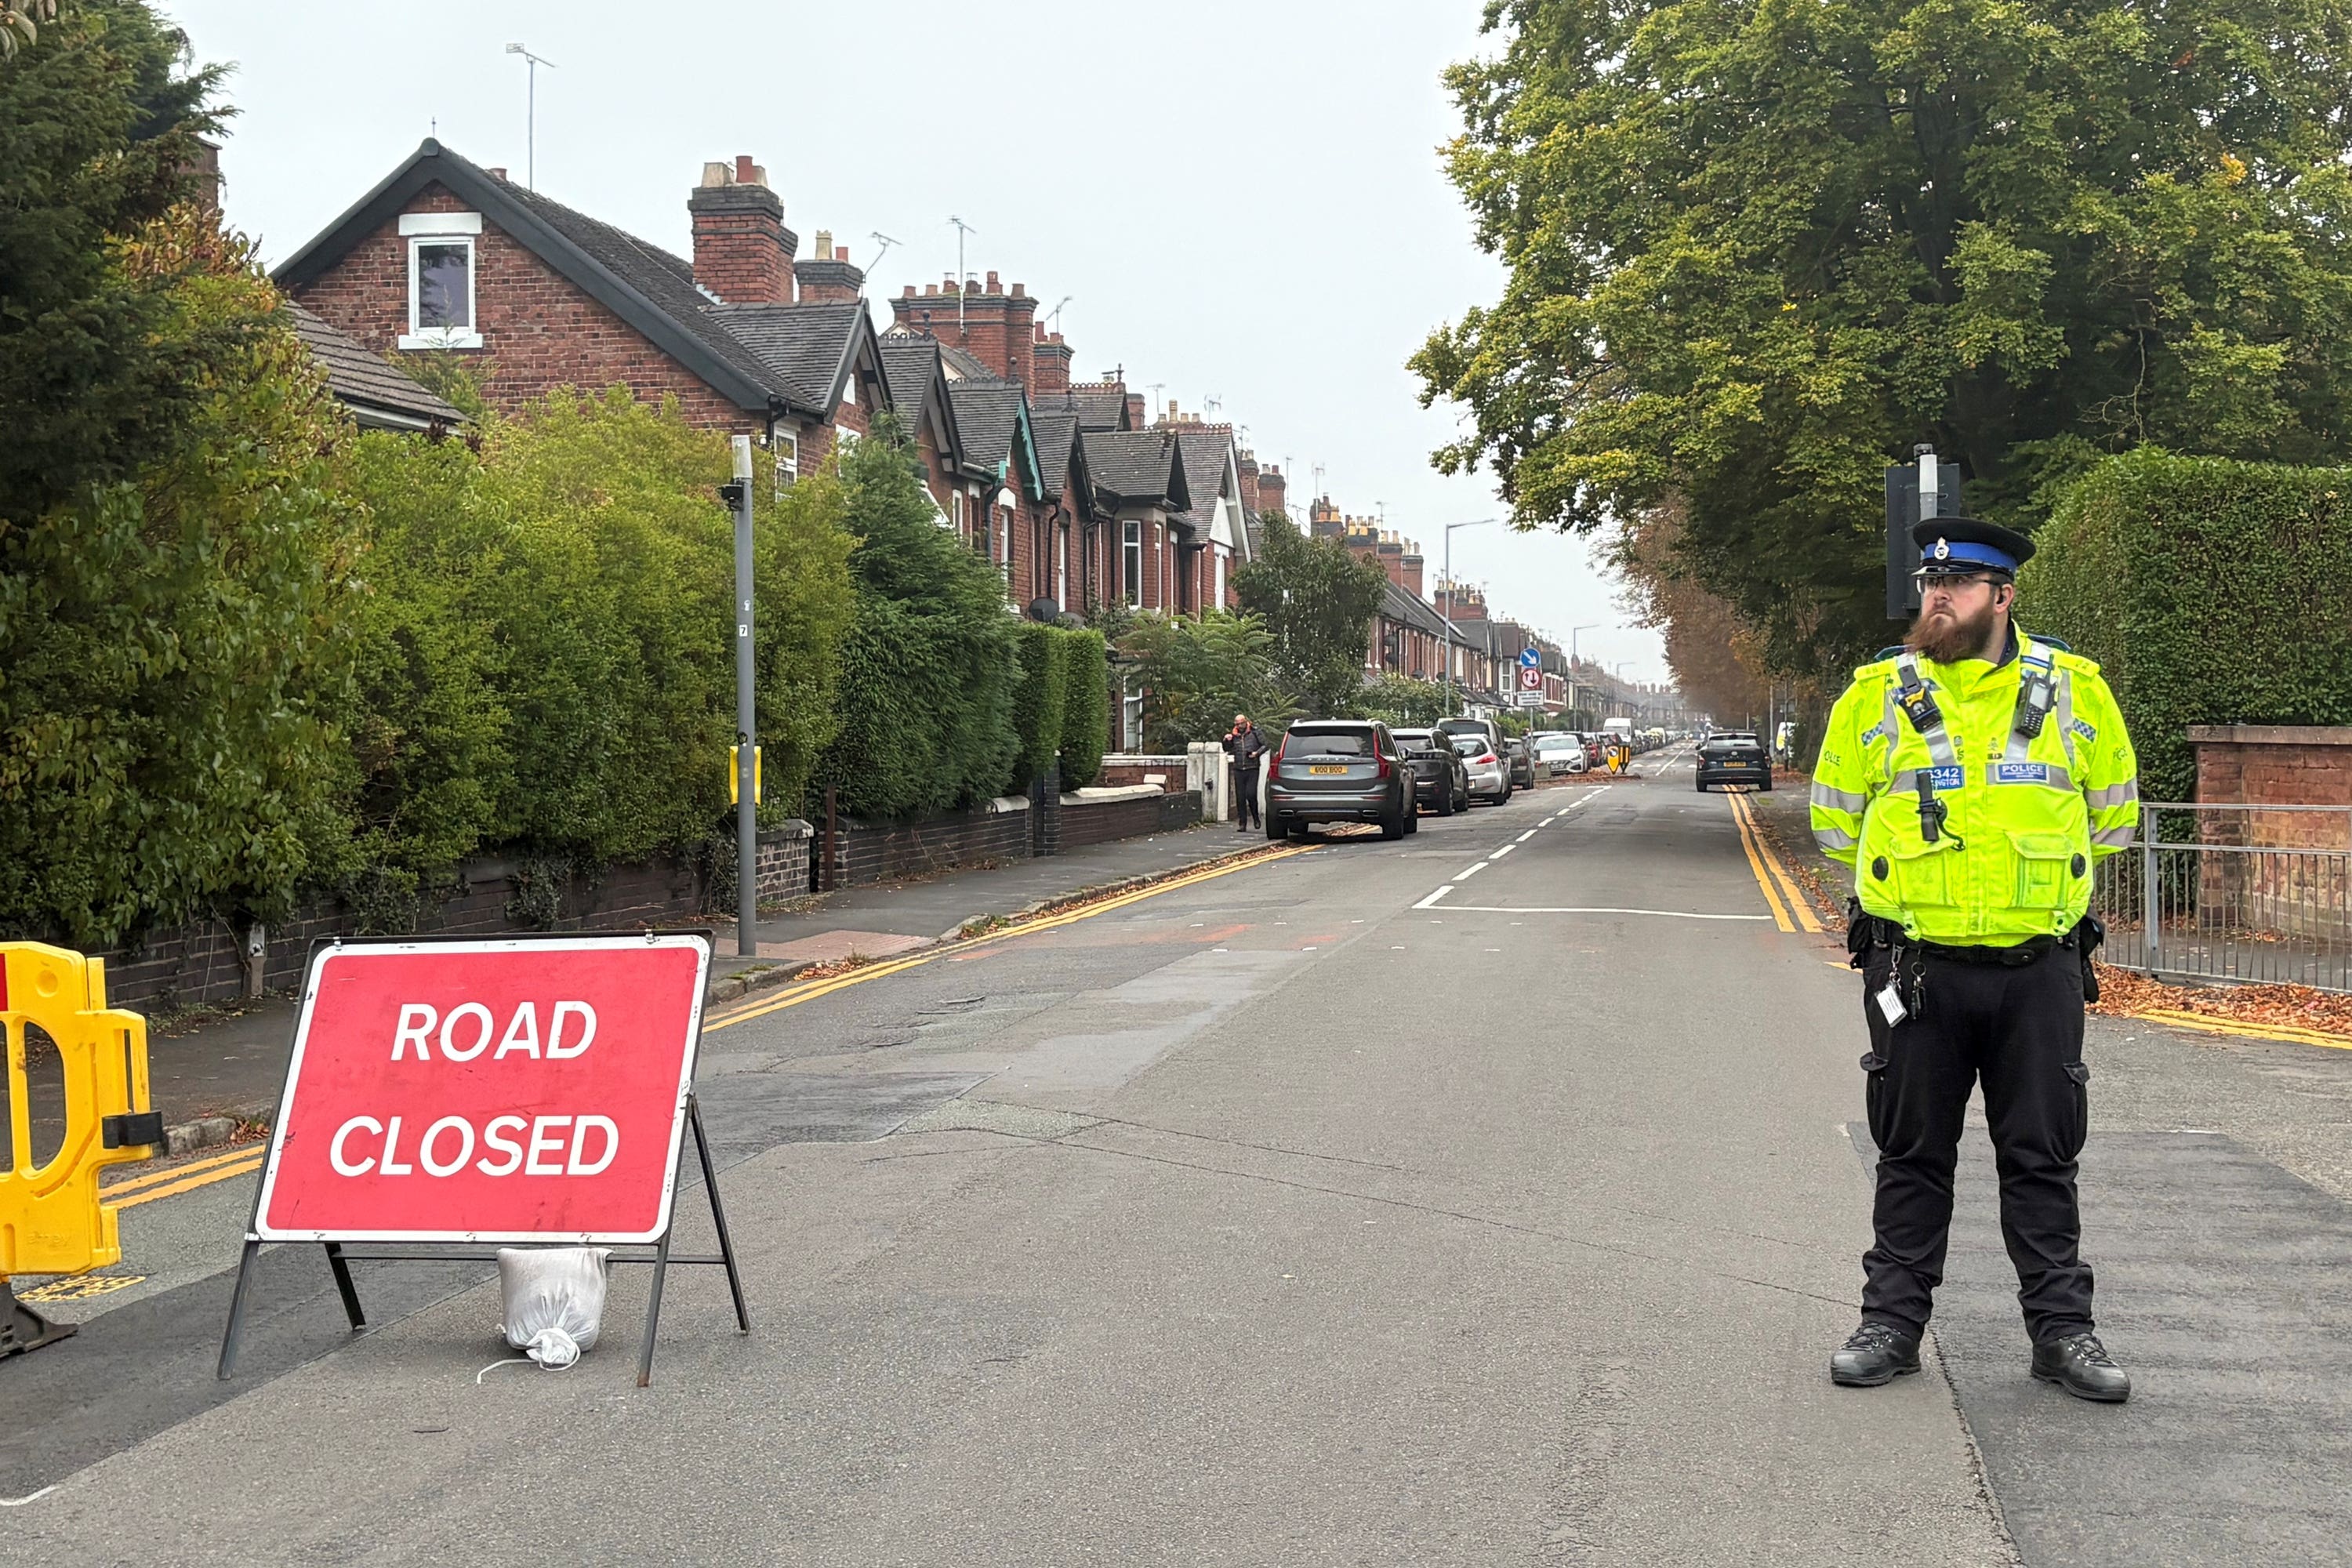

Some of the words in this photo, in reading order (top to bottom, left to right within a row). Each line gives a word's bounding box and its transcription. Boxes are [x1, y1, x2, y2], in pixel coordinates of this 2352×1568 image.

[2002, 764, 2044, 773] POLICE
[390, 1000, 597, 1062] ROAD
[329, 1114, 619, 1178] CLOSED
